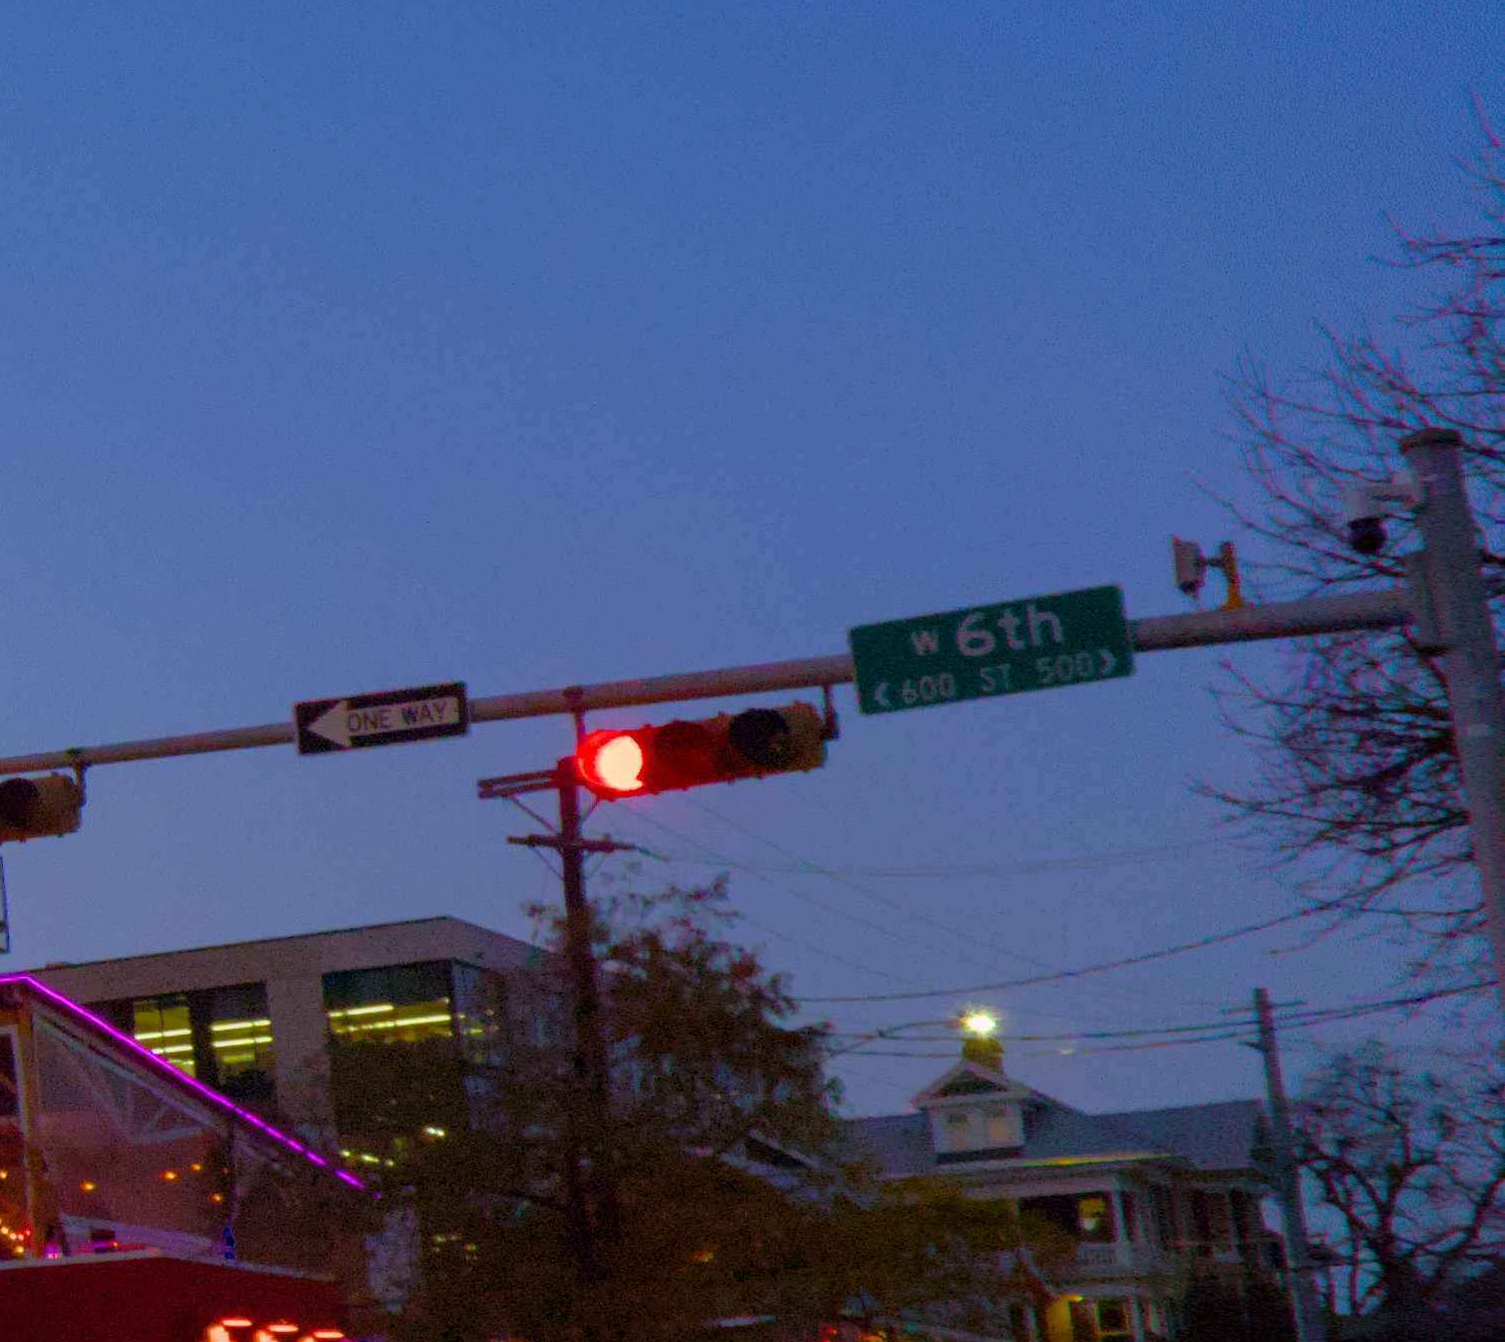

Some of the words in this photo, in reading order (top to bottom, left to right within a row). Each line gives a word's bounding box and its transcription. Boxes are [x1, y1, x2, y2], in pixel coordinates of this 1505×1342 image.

[910, 628, 939, 657] W
[956, 602, 1064, 657] 6th
[902, 672, 955, 705] 600
[979, 663, 1011, 693] ST
[1035, 651, 1095, 684] 500
[347, 709, 392, 732] ONE
[400, 700, 447, 725] WAY
